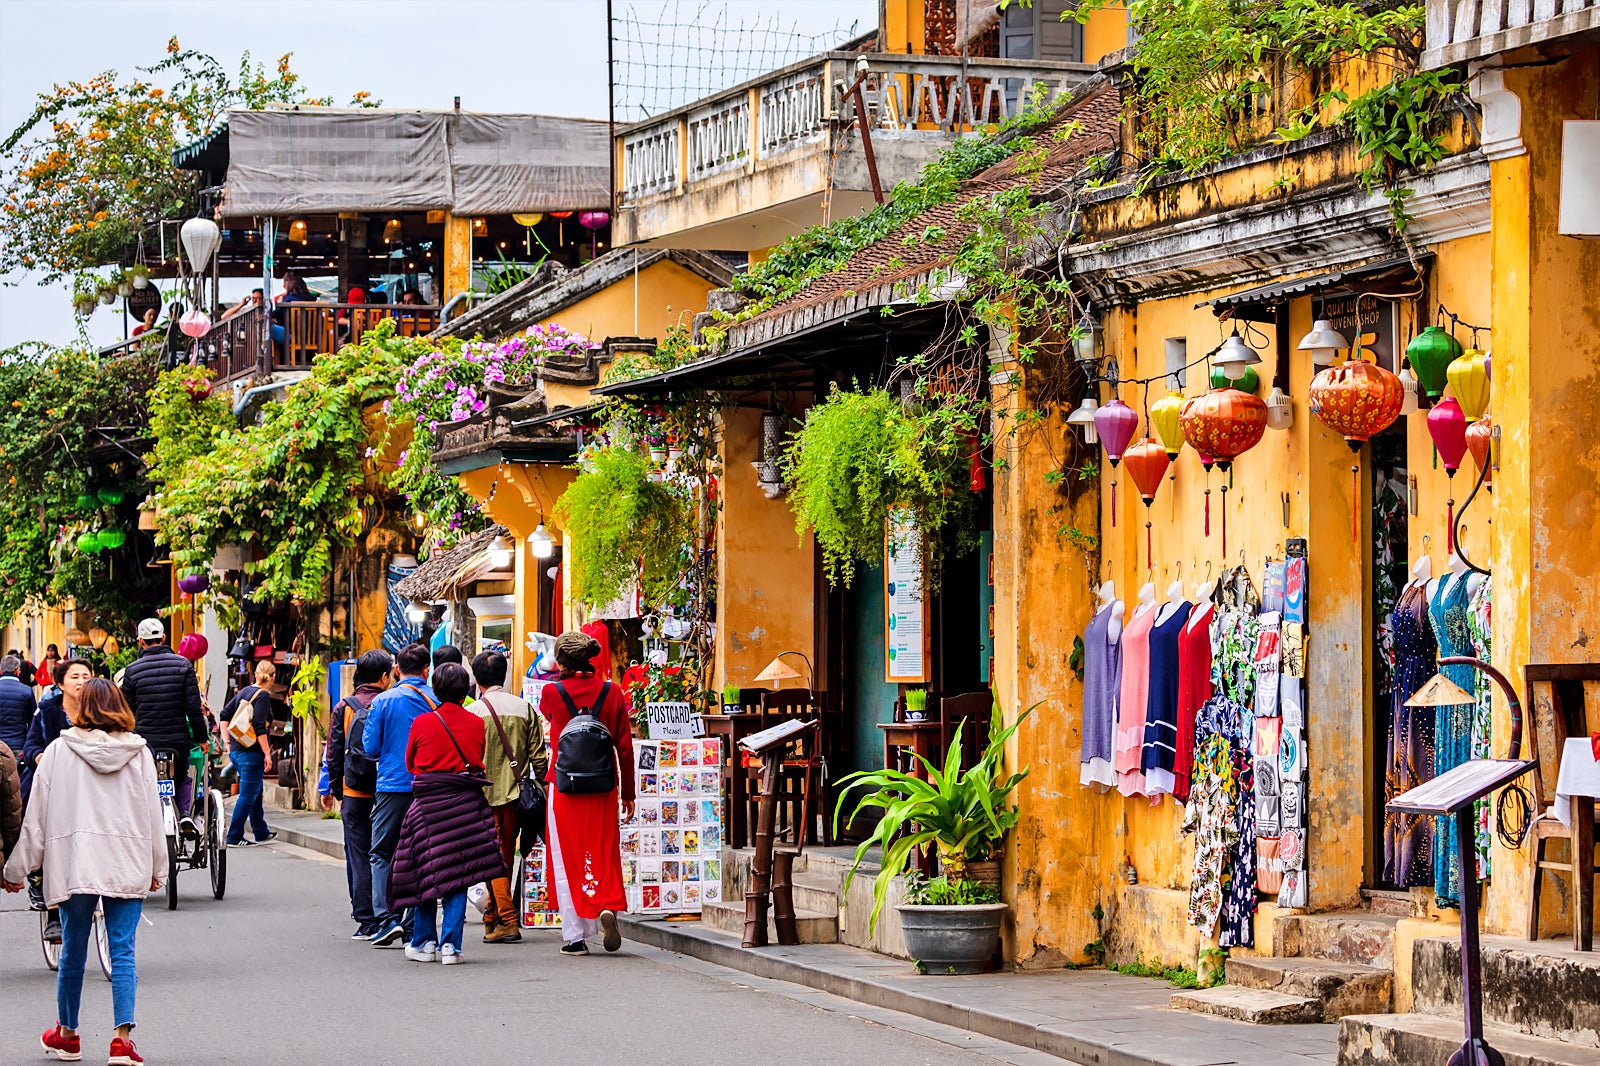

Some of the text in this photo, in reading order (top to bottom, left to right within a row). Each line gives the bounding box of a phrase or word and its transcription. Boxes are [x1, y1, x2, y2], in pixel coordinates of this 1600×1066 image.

[1329, 311, 1380, 330] OUVENIR SHOP
[648, 705, 690, 724] POSTCARD
